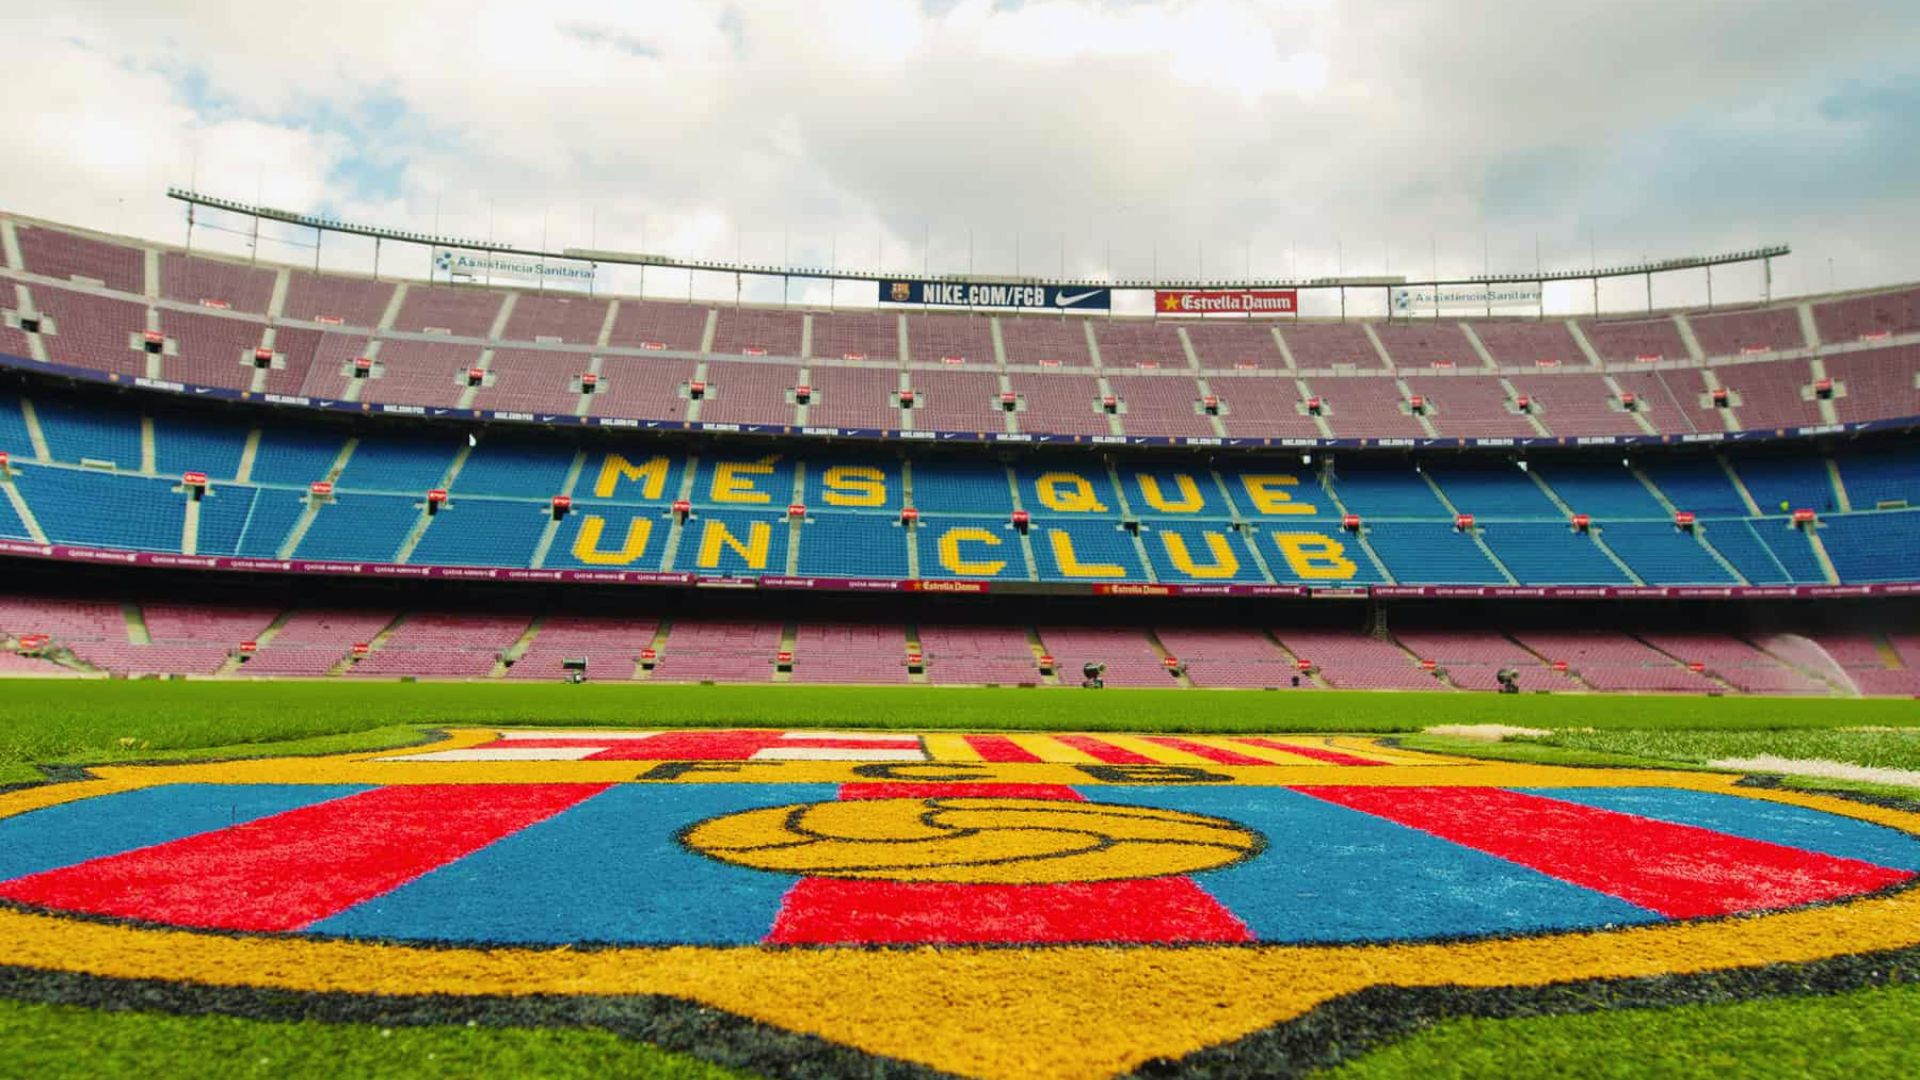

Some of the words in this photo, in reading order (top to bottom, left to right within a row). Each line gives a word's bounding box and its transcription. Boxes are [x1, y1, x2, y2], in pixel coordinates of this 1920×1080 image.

[922, 284, 1045, 306] NIKE.COM/FCB
[1181, 294, 1240, 310] Estrella
[1241, 294, 1291, 310] Damm
[593, 453, 887, 507] MÉS
[1036, 472, 1317, 515] QUE
[572, 515, 773, 569] UN
[937, 527, 1358, 579] CLUB
